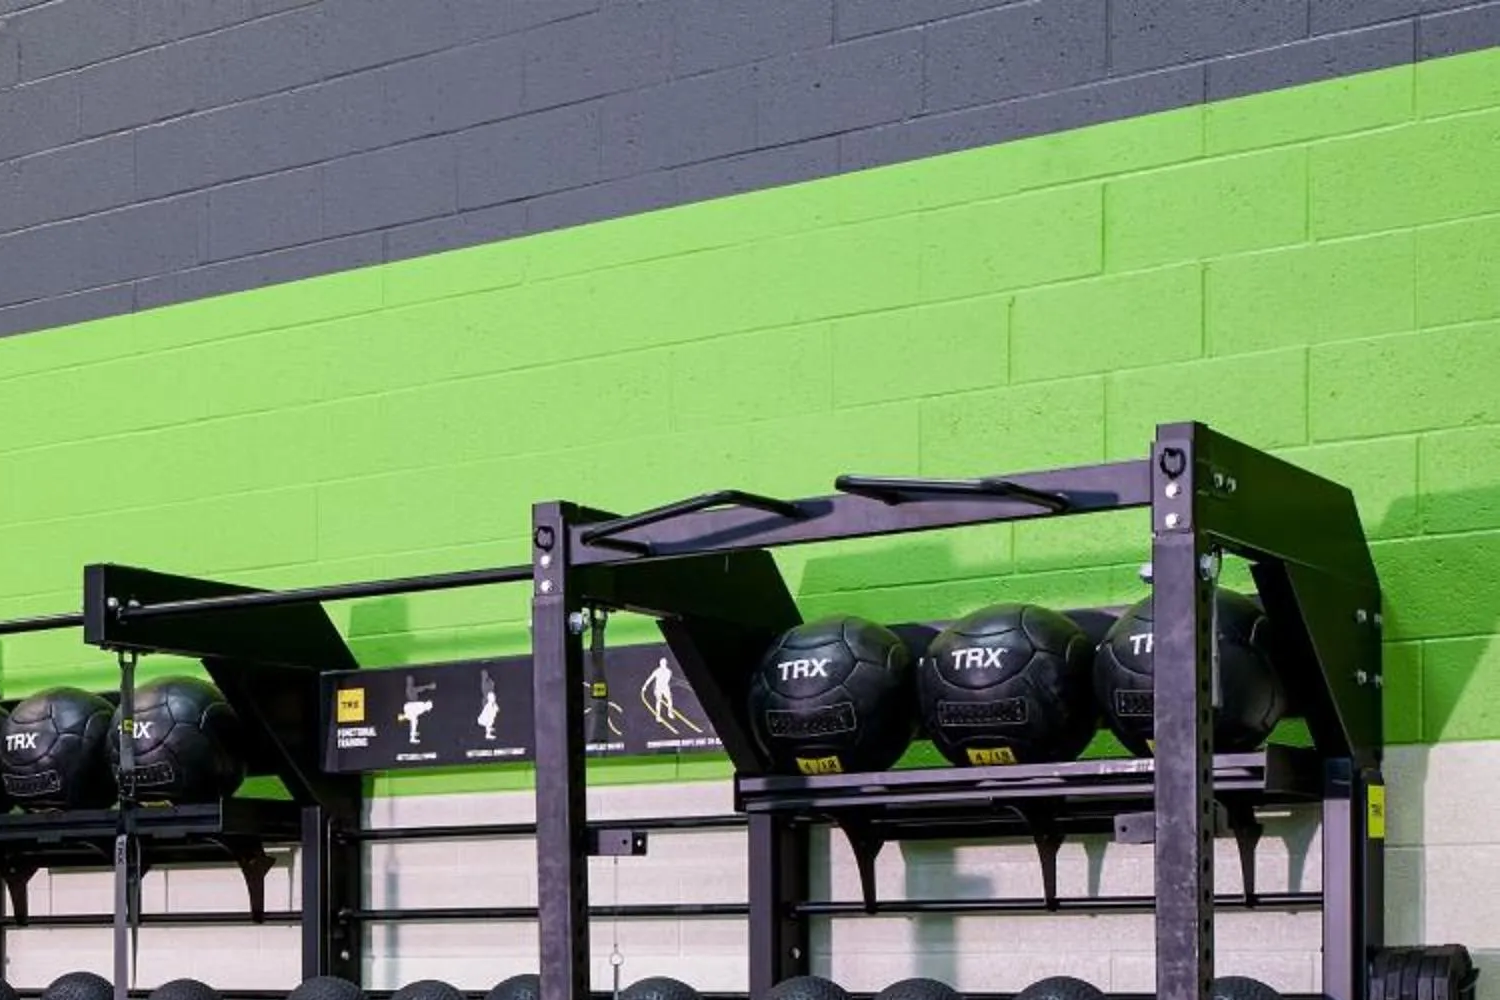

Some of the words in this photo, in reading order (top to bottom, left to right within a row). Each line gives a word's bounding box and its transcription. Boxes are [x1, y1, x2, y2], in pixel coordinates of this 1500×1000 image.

[777, 658, 831, 681] TRX
[952, 648, 1007, 670] TRX
[5, 731, 40, 751] TRX
